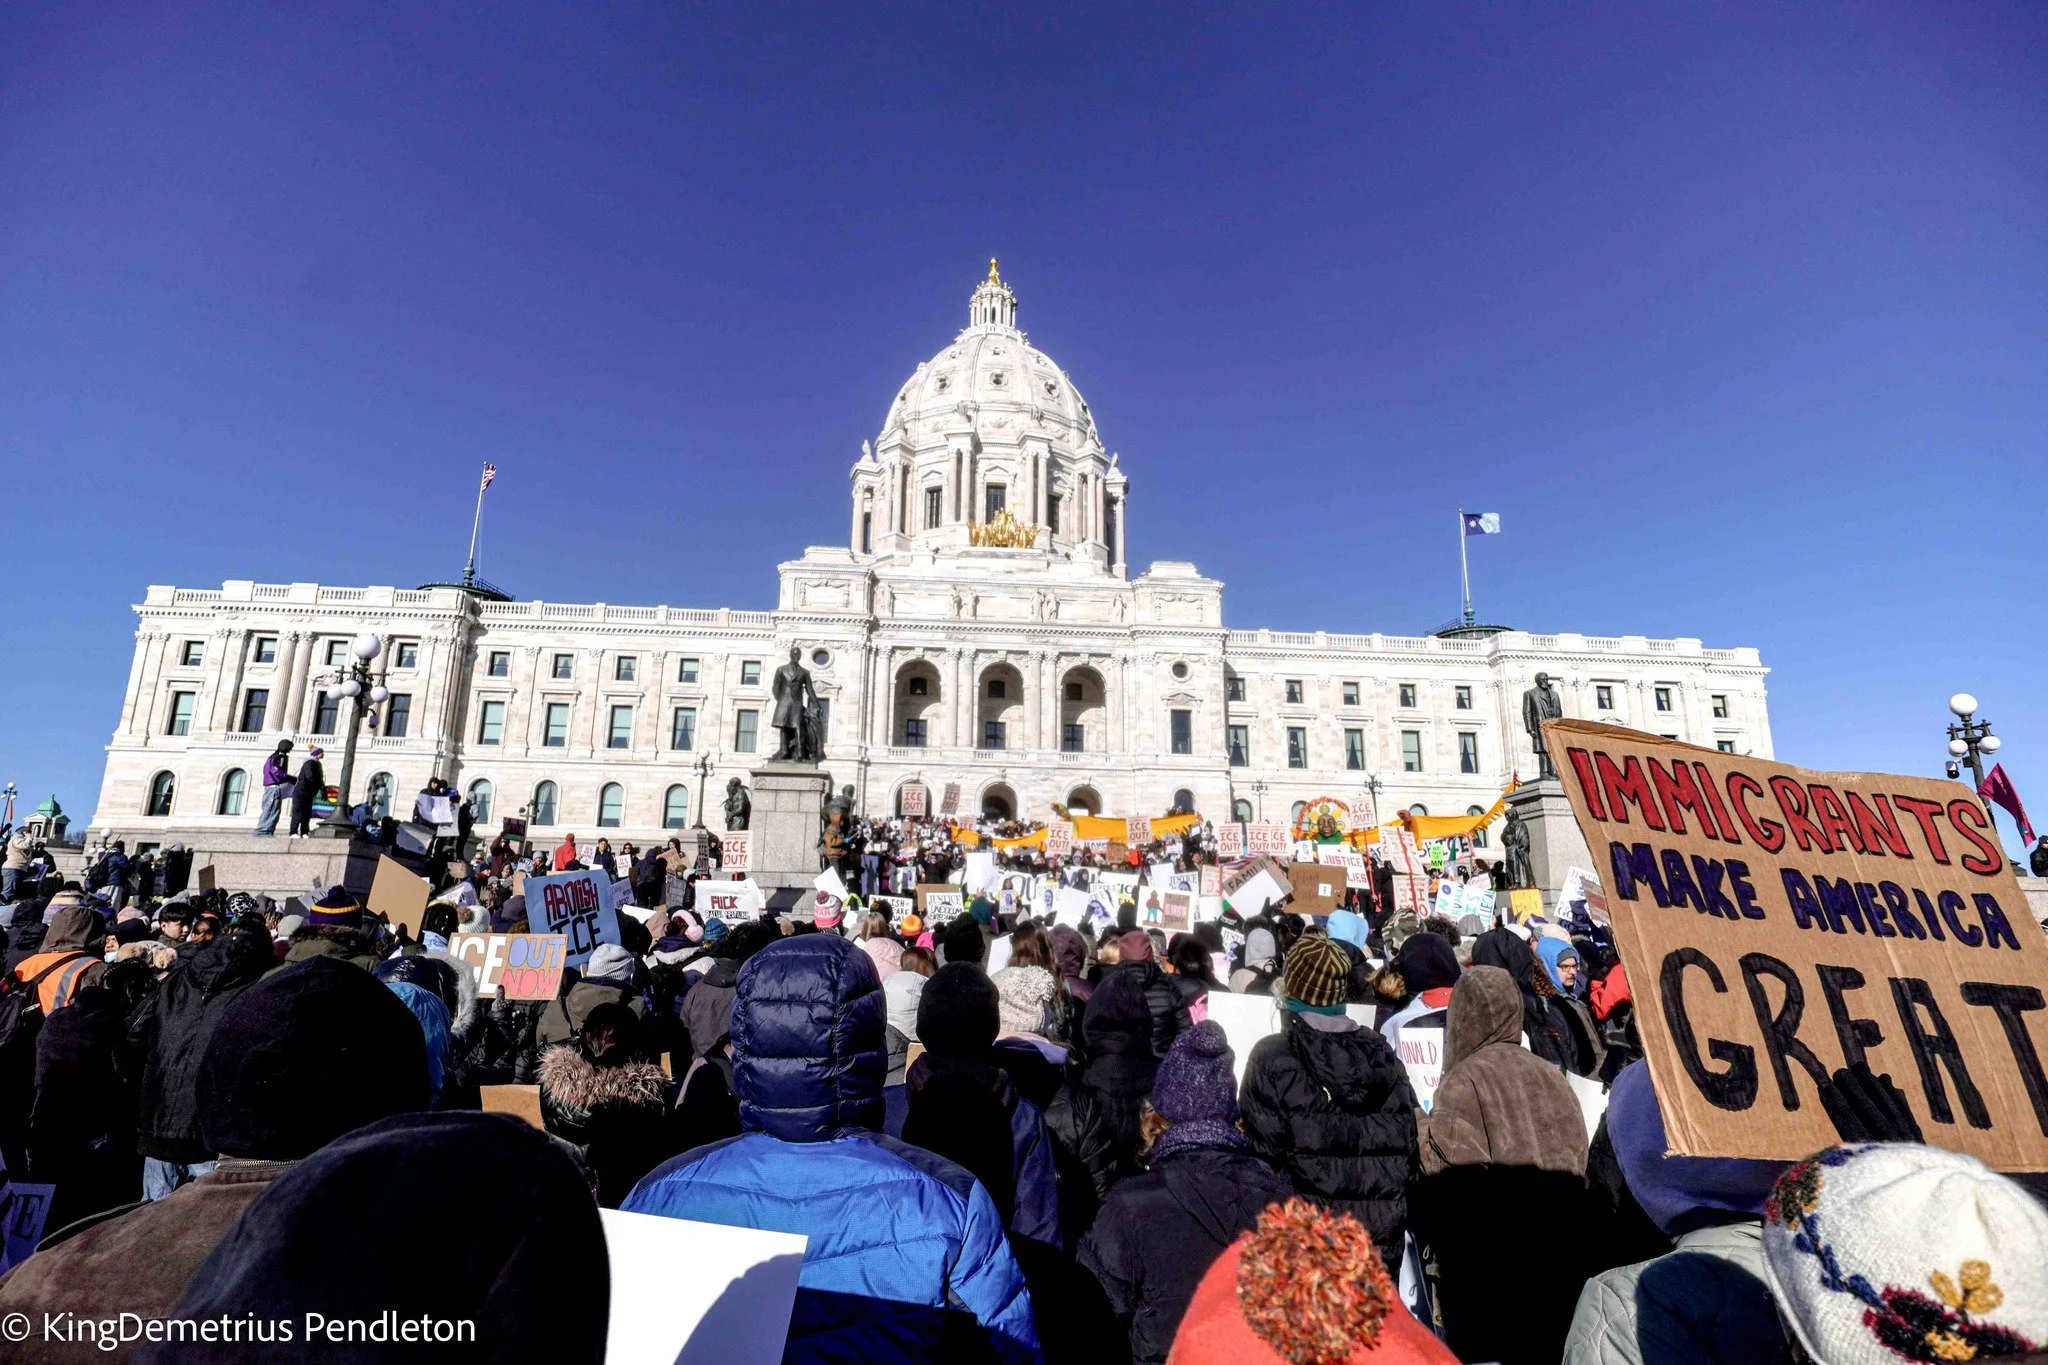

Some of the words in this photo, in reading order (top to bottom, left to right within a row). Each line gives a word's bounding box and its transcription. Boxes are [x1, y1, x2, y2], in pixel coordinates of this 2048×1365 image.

[904, 792, 923, 801] ICE
[903, 801, 923, 810] OUT!
[1352, 803, 1371, 814] ICE
[1566, 747, 2003, 876] IMMIGRANTS
[1353, 813, 1374, 824] OUT!
[1129, 822, 1148, 832] ICE
[1050, 829, 1069, 840] ICE
[1129, 832, 1149, 841] OUT!
[1220, 832, 1239, 842] ICE
[1249, 831, 1268, 842] ICE
[725, 841, 747, 853] ICE
[1049, 839, 1069, 849] OUT!
[1220, 842, 1241, 852] OUT!
[1249, 841, 1269, 851] OUT!
[723, 854, 748, 866] OUT!
[1323, 854, 1363, 867] JUSTICE
[543, 877, 600, 926] ABOLISH
[1609, 841, 1766, 920] MAKE
[1780, 866, 2022, 951] AMERICA
[711, 895, 738, 910] FUCK
[549, 912, 605, 956] ICE
[450, 935, 507, 994] ICE
[508, 937, 567, 969] OUT
[502, 969, 561, 998] NOW
[1659, 947, 2048, 1138] GREAT
[1401, 1041, 1437, 1065] ONALD
